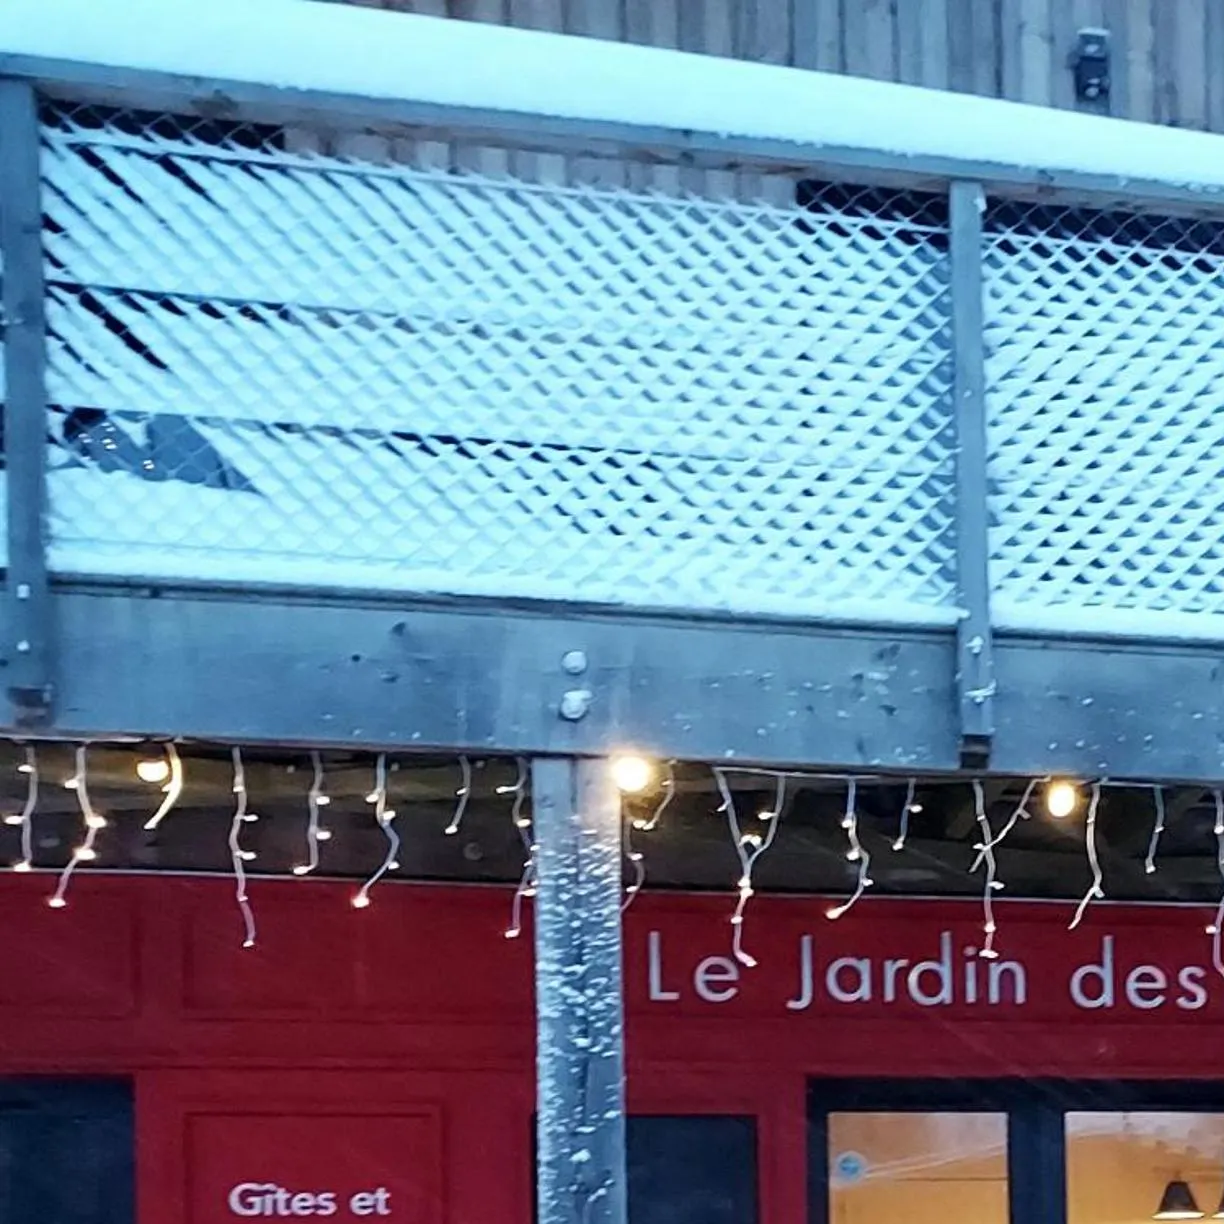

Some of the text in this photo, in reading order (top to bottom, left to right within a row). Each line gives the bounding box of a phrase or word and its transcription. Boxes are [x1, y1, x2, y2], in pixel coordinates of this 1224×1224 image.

[648, 931, 740, 1002] Le
[786, 931, 1026, 1010] Jardin
[1069, 935, 1208, 1010] des
[228, 1182, 392, 1217] Gîtes et
